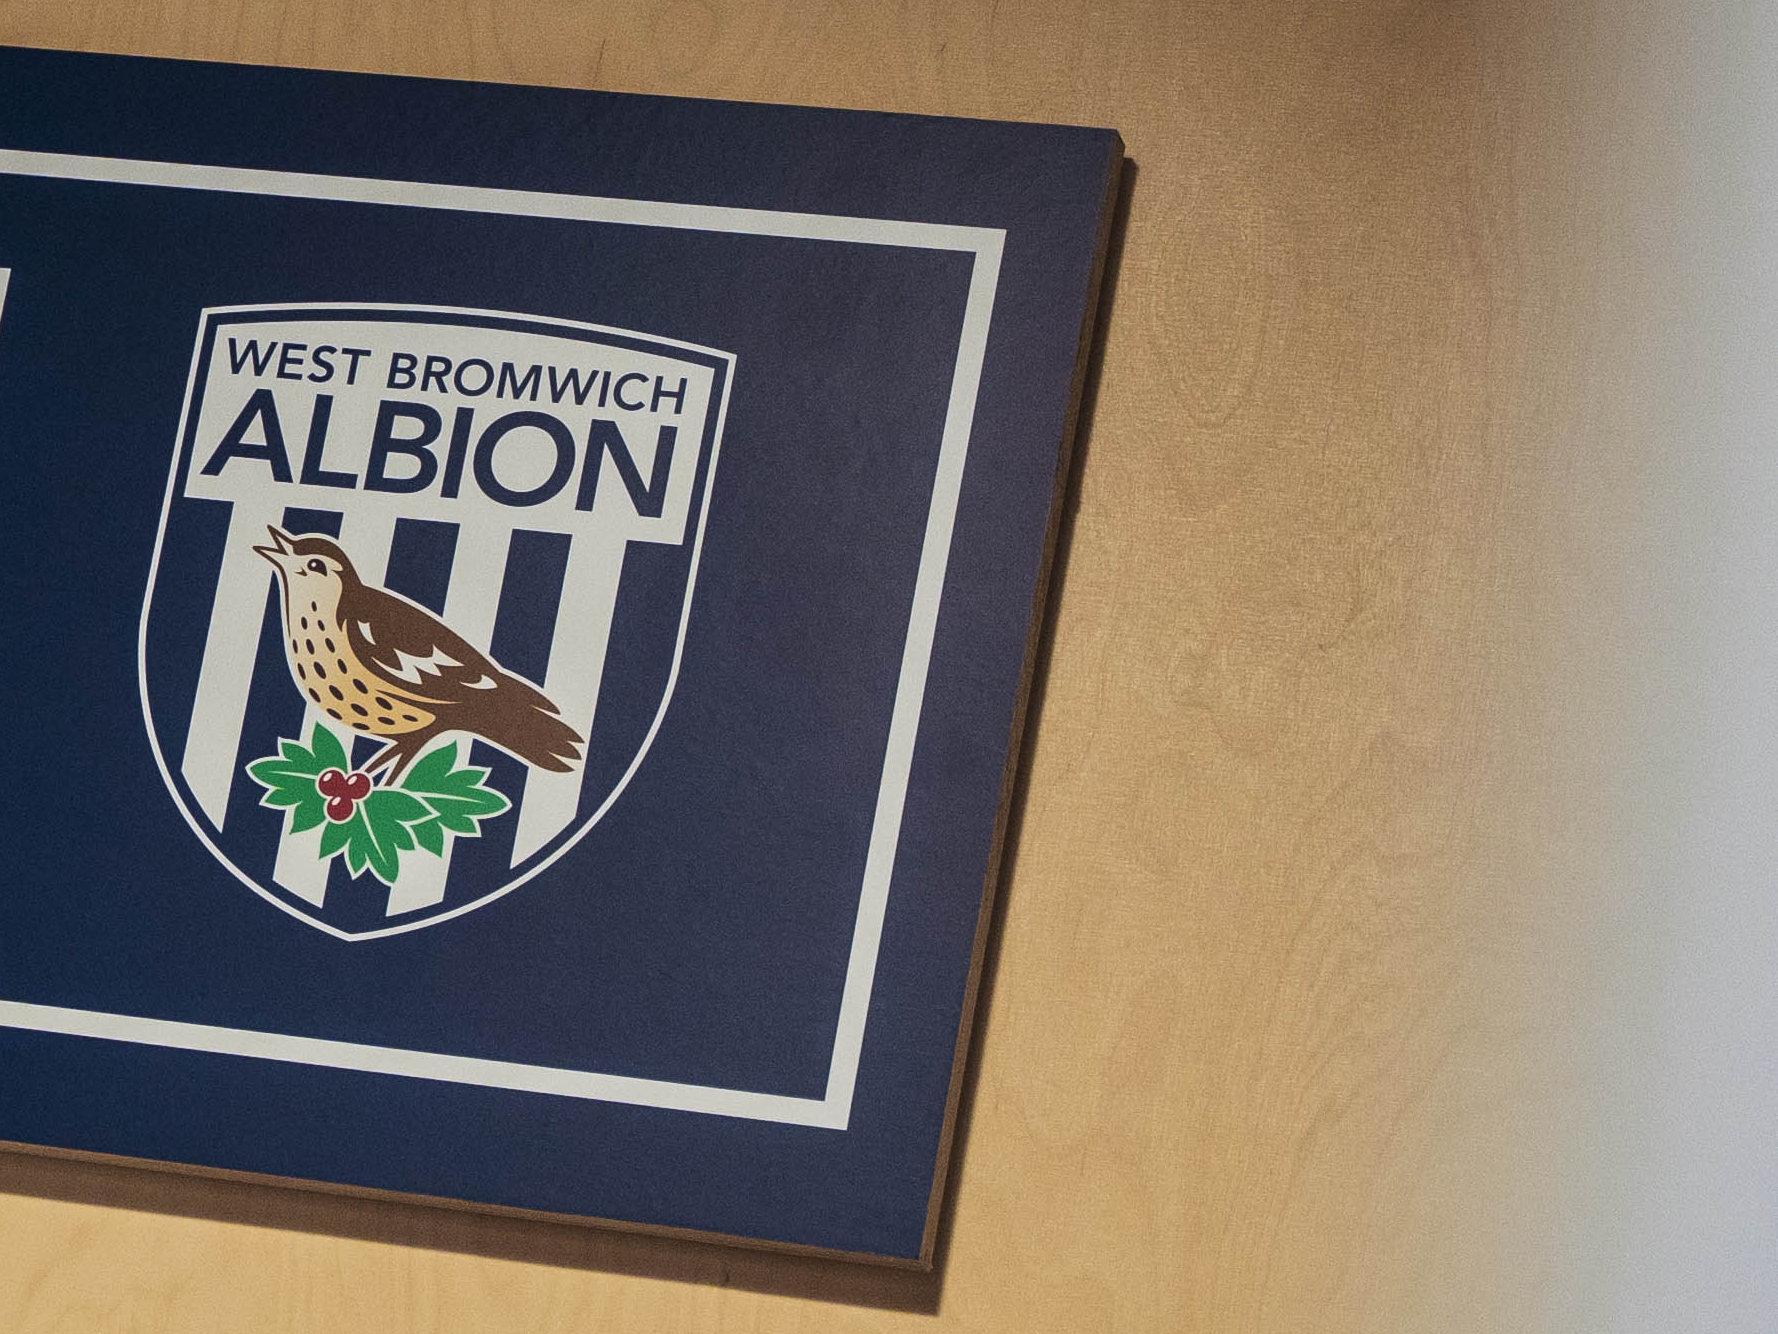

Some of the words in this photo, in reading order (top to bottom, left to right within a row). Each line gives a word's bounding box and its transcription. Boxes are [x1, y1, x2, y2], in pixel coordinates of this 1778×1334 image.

[229, 338, 371, 384] WEST
[387, 353, 687, 414] BROMWICH
[201, 389, 677, 518] ALBION
